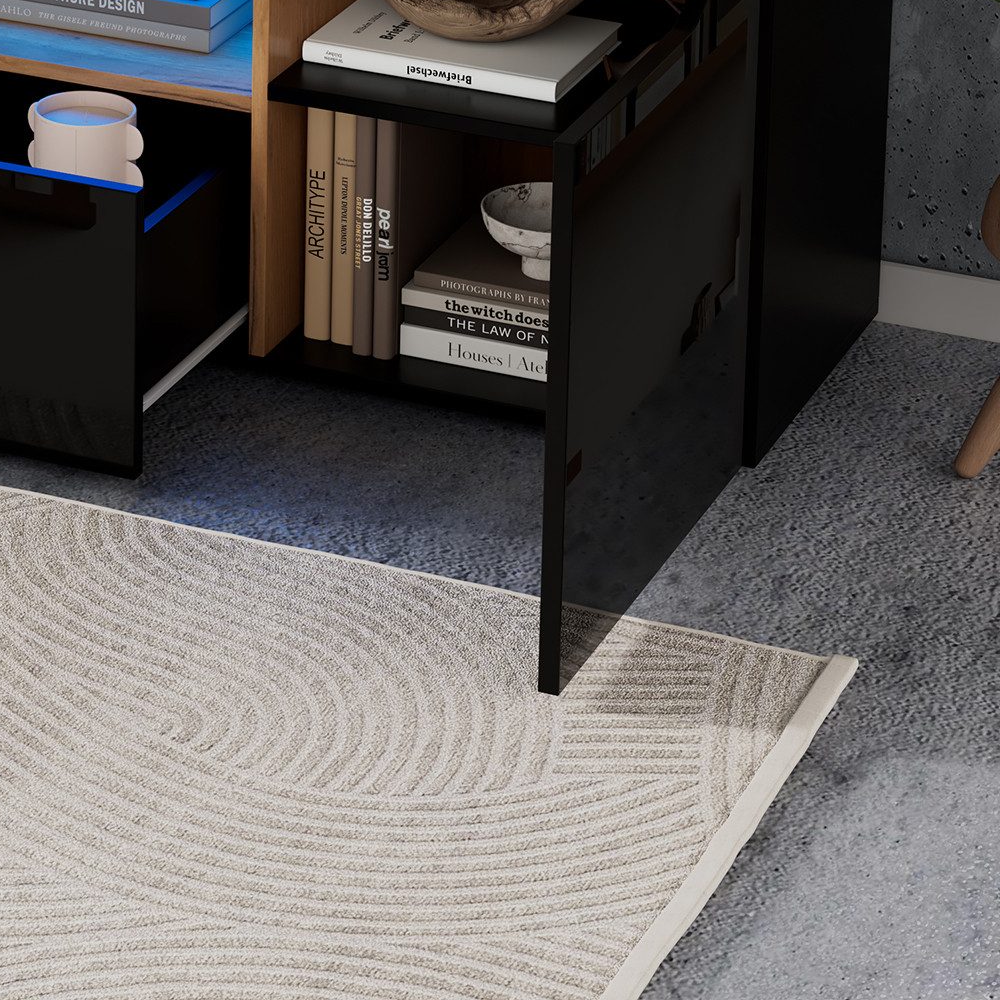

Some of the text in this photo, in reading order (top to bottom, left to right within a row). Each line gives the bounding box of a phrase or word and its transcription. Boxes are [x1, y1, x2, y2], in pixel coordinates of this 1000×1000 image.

[38, 11, 55, 20] THE
[57, 14, 87, 25] GISELE
[89, 20, 123, 32] FREUND
[125, 25, 187, 41] PHOTOGRAPHS
[407, 65, 473, 85] Briefwechsel
[308, 169, 326, 260] ARCHITYPE
[362, 198, 373, 263] DON DELILLO
[376, 207, 394, 281] pearl jam
[440, 279, 512, 299] PHOTOGRAPHS
[514, 293, 525, 302] BY
[445, 300, 549, 328] the witch does
[447, 317, 476, 331] THE
[482, 323, 512, 338] LAW
[516, 330, 535, 342] OF
[448, 341, 503, 367] Houses
